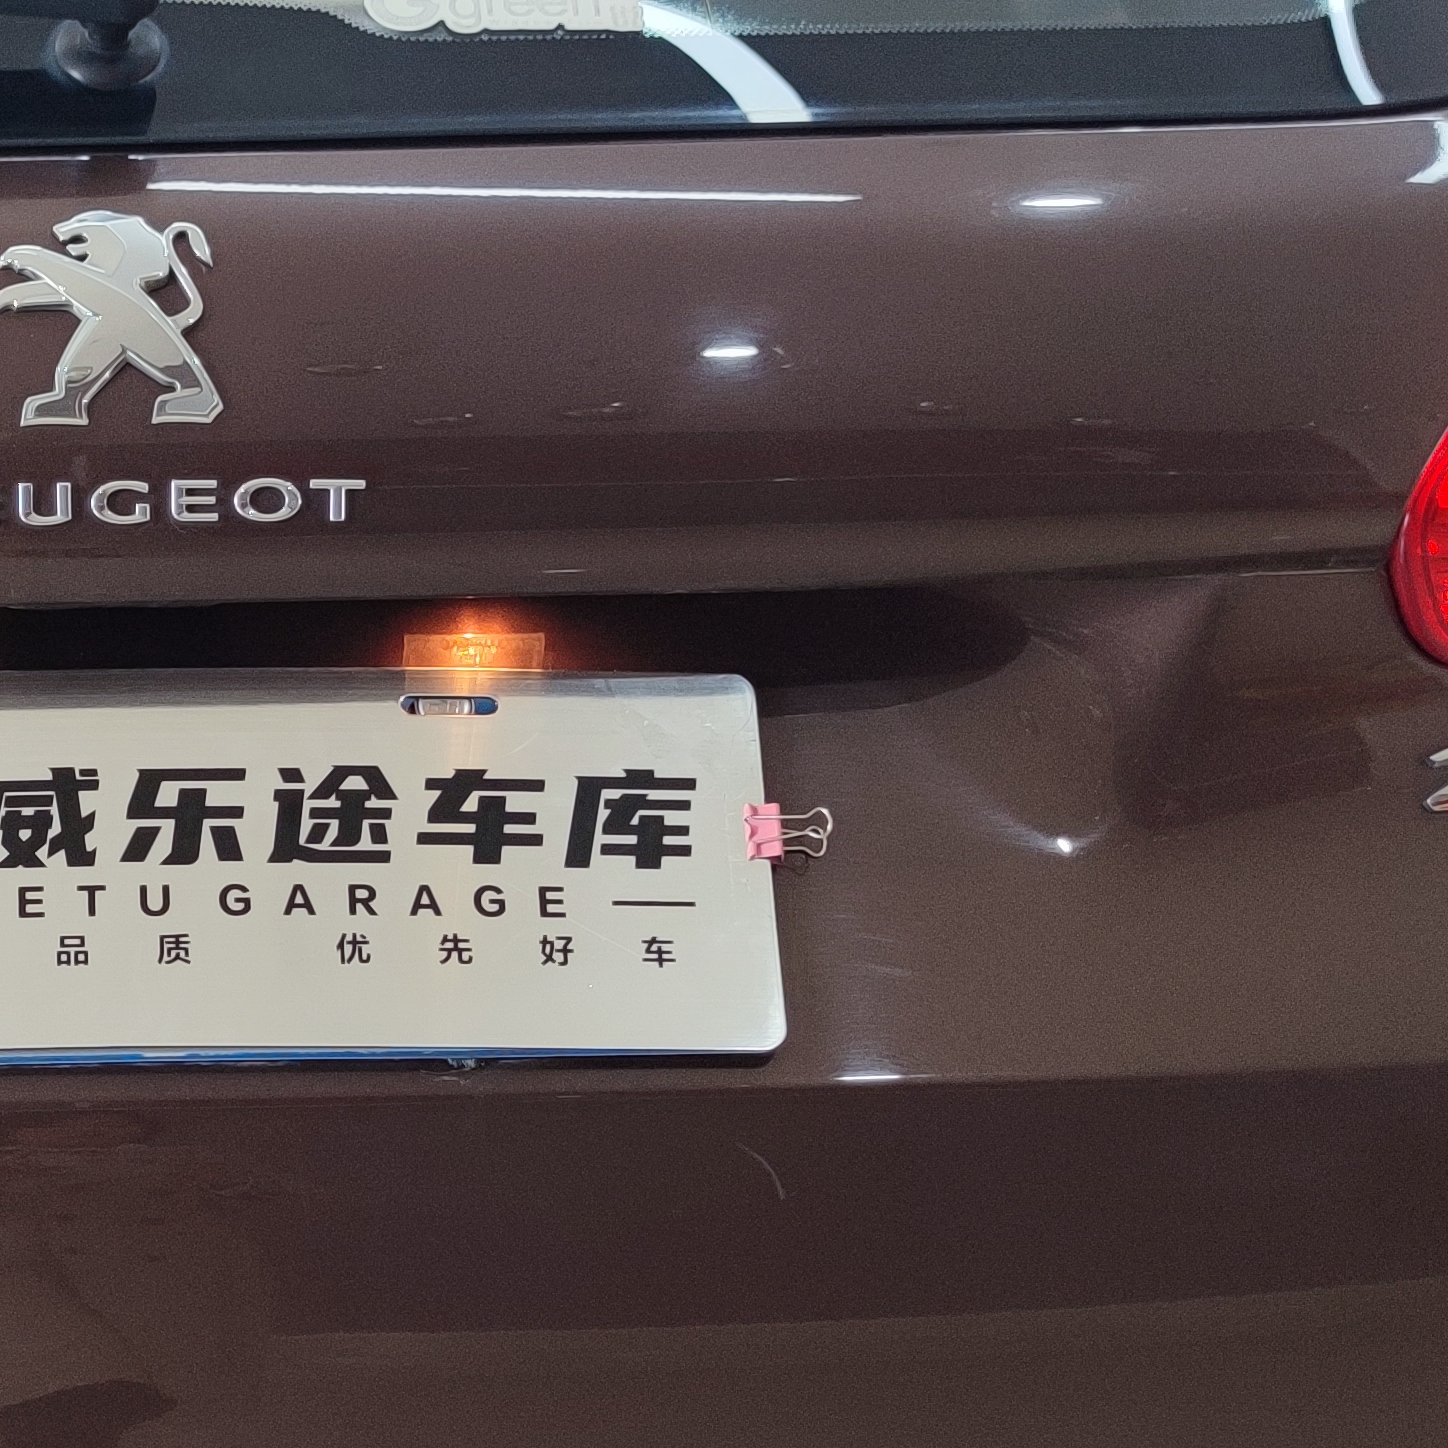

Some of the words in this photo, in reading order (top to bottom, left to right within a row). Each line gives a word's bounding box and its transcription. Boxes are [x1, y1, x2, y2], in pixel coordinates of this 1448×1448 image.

[218, 883, 567, 918] GARAGE
[336, 932, 677, 968] 优先好车
